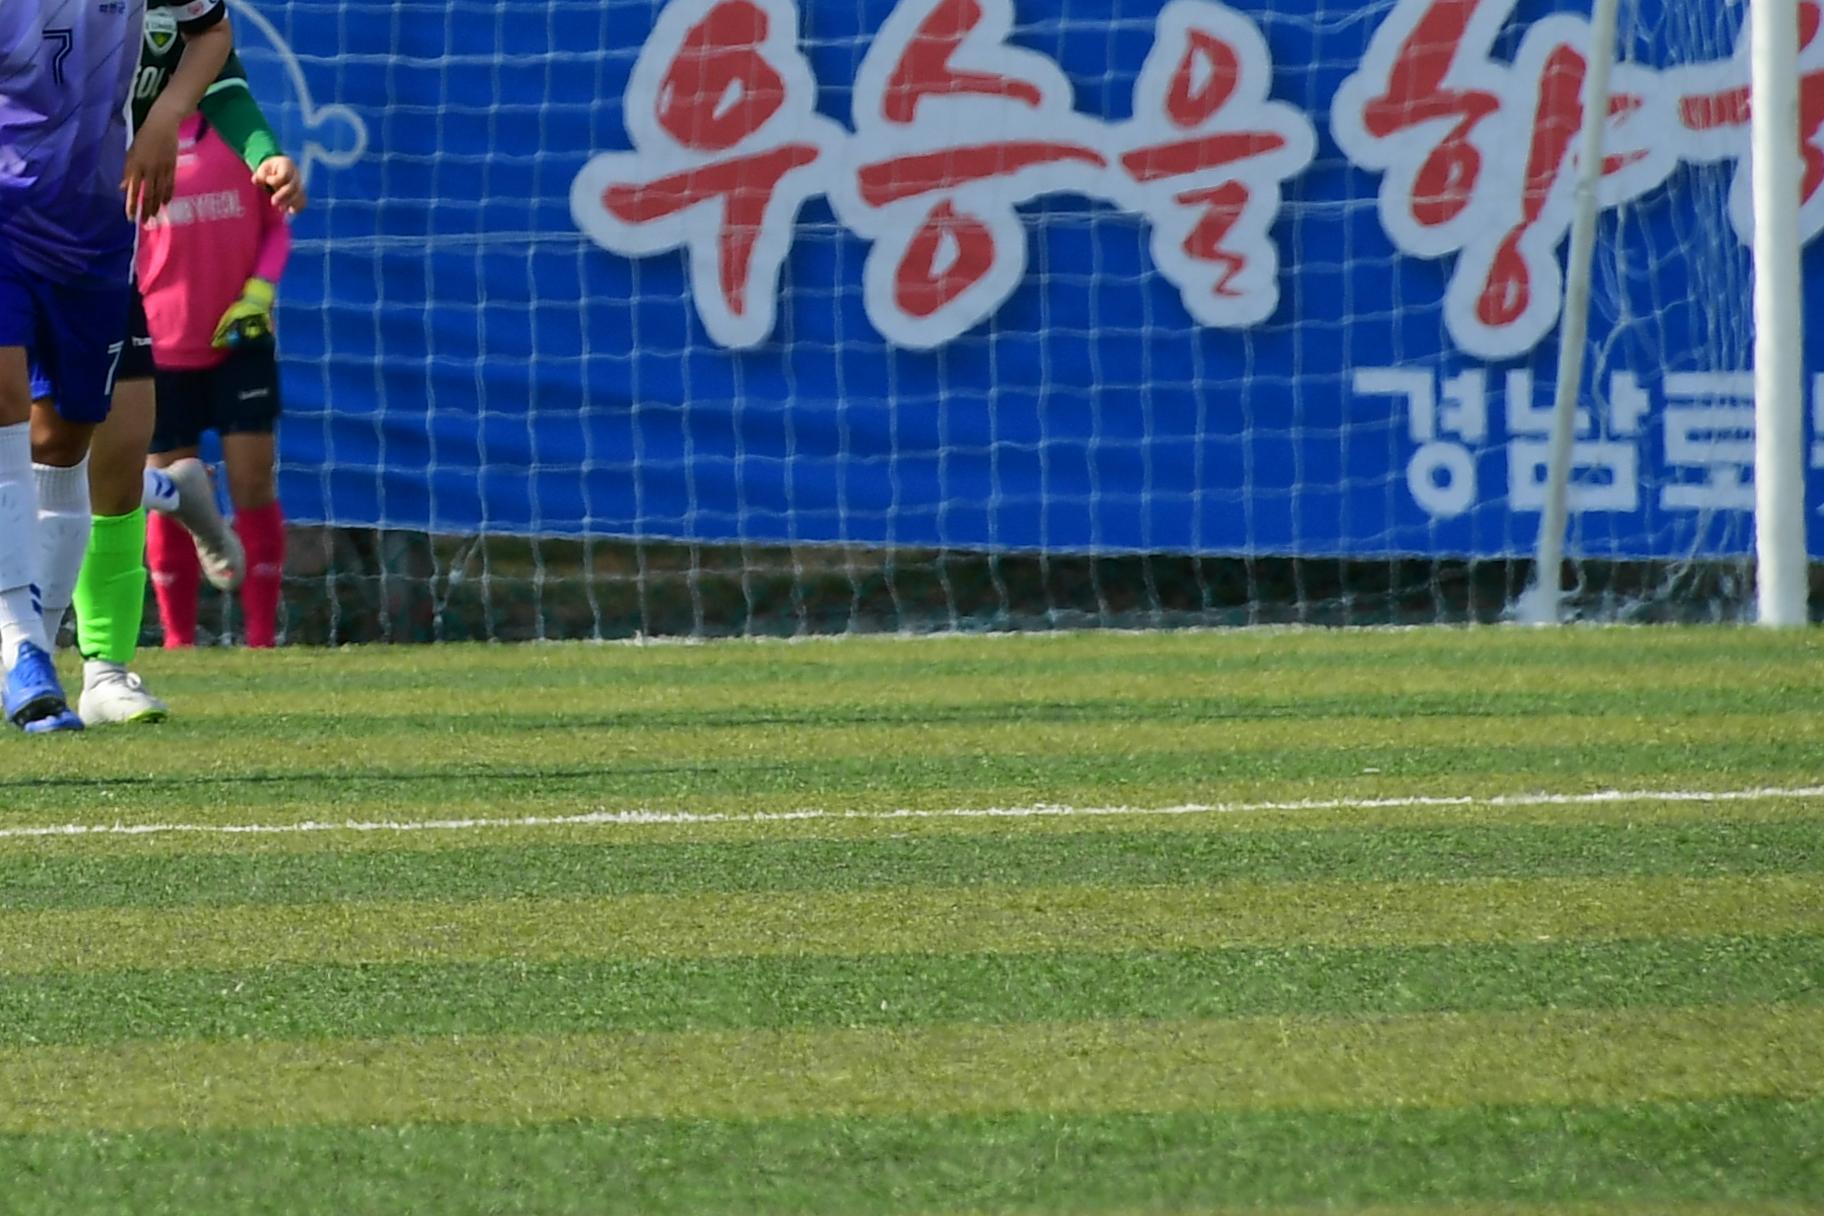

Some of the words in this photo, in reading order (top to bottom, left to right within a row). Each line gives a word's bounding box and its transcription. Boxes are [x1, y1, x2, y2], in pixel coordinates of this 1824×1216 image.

[42, 28, 73, 87] 7
[104, 340, 124, 396] 7
[1352, 367, 1824, 517] 경남로
